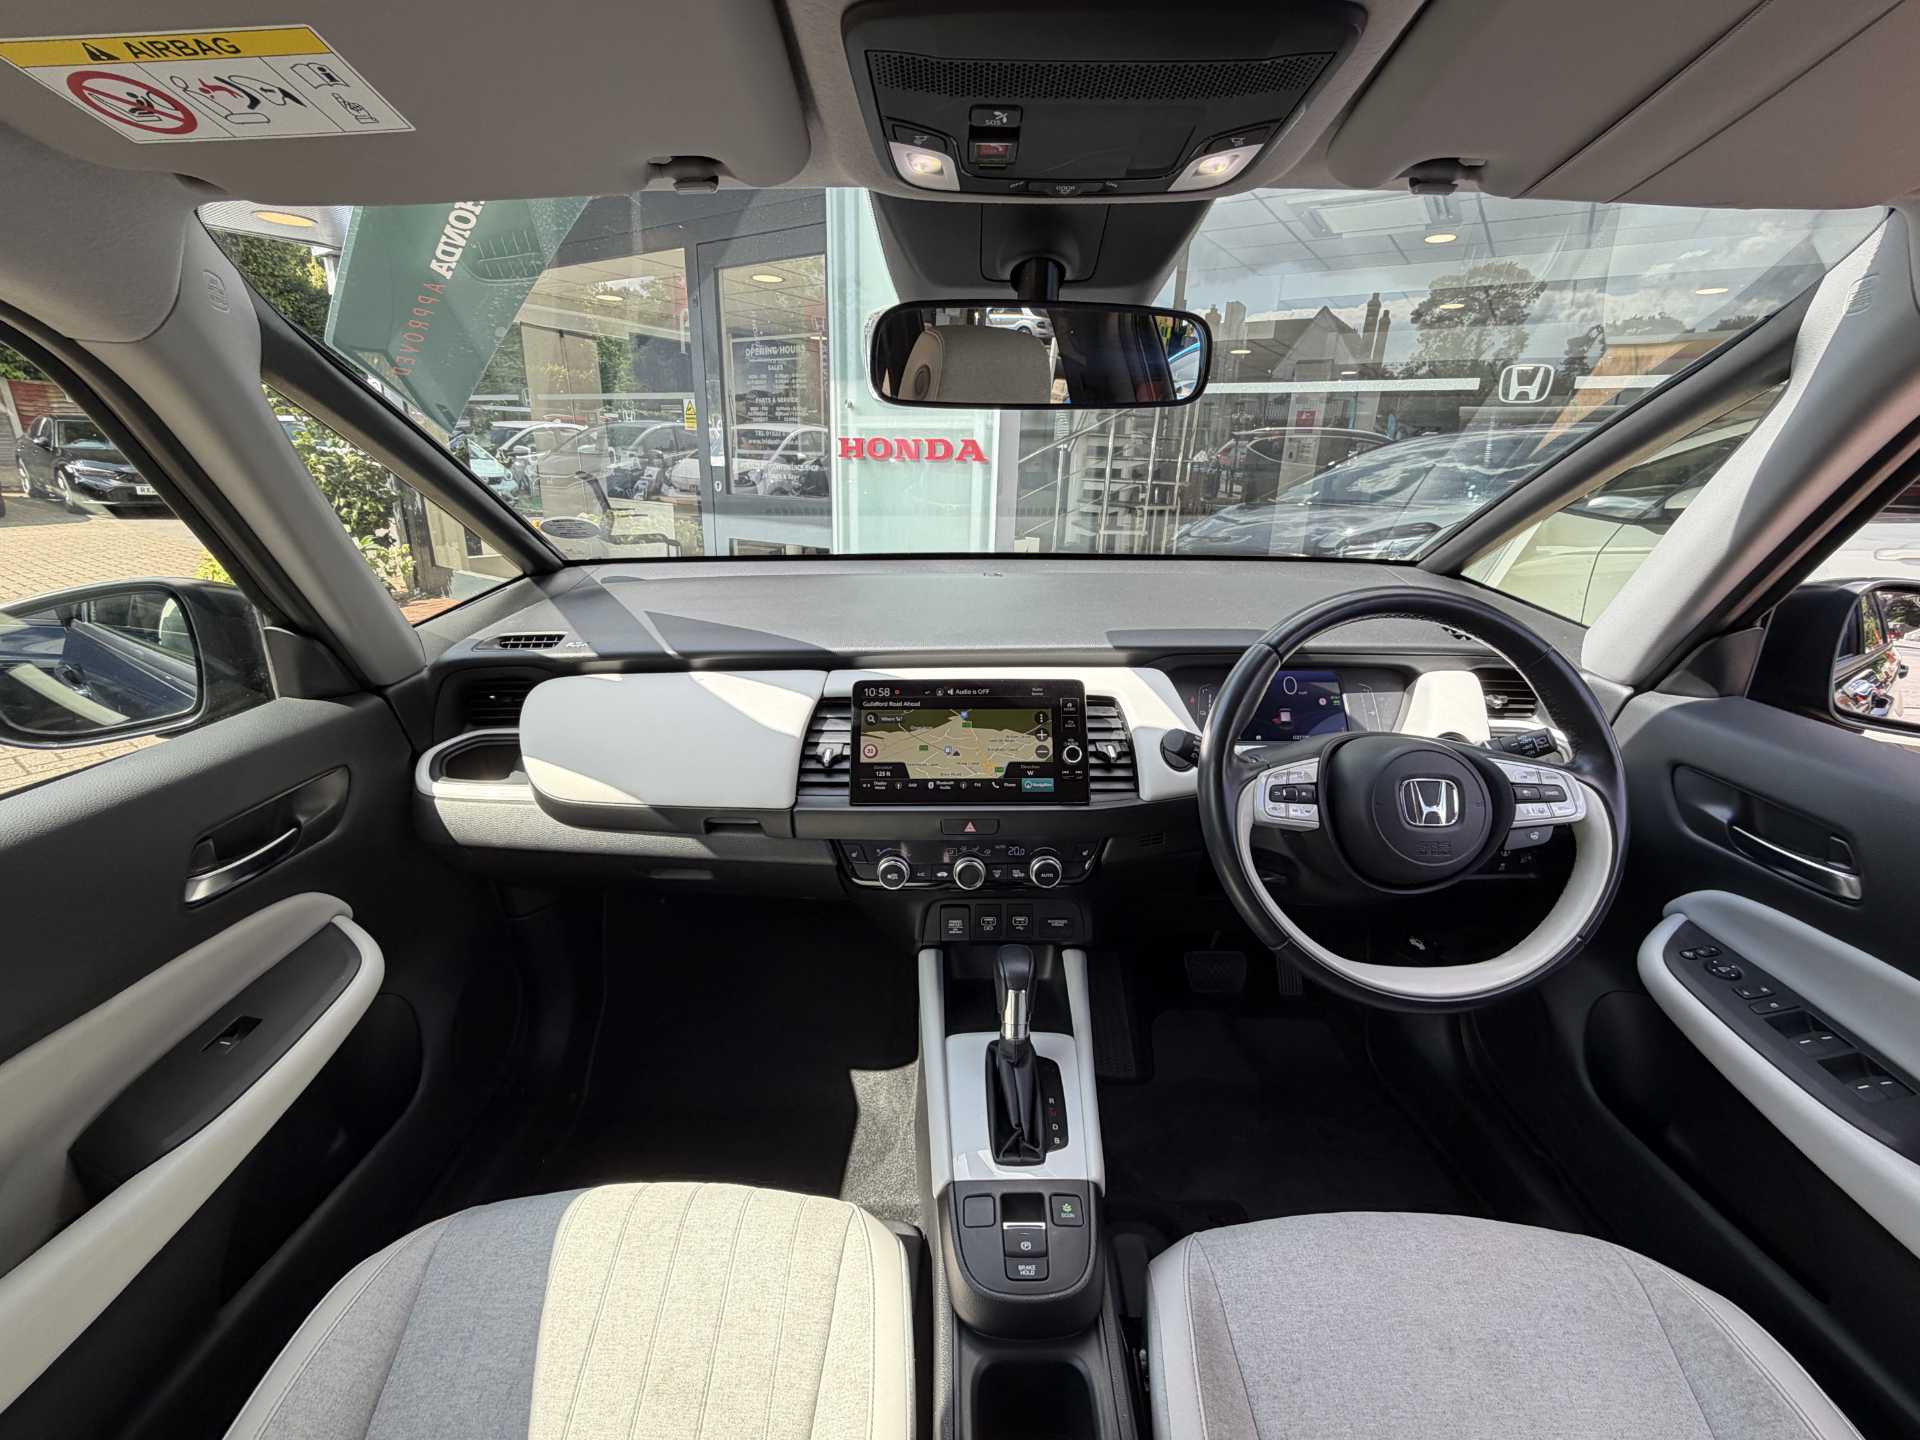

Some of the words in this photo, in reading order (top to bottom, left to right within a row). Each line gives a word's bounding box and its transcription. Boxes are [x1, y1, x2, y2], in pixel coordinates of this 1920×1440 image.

[123, 37, 241, 59] AIRBAG
[745, 346, 779, 357] OPENING
[838, 437, 987, 463] HONDA
[863, 687, 890, 697] 10:58
